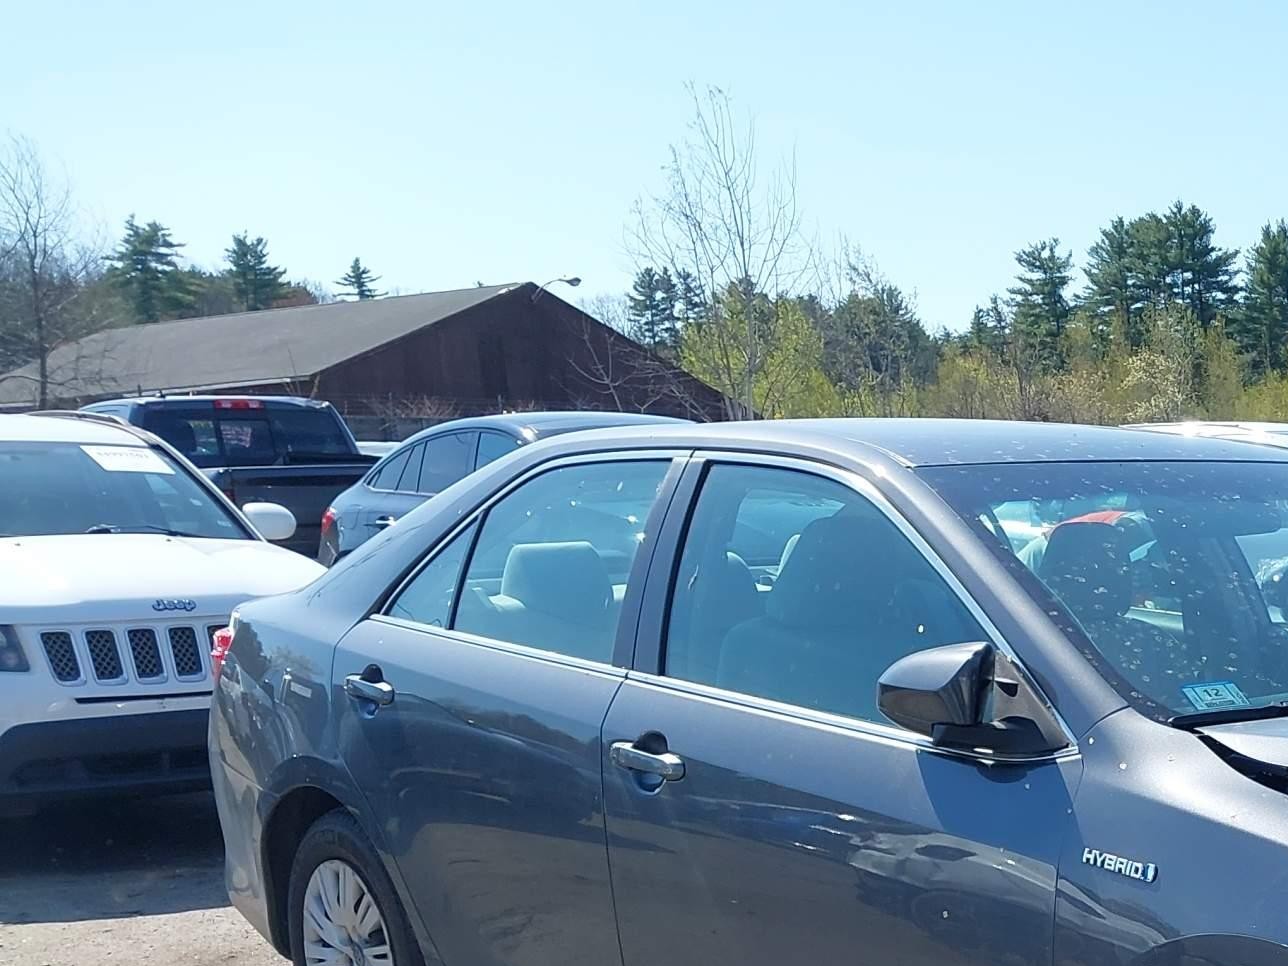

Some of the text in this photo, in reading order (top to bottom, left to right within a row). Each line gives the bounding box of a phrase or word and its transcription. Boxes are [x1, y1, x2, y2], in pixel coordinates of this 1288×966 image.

[152, 599, 197, 611] Jeep
[1203, 688, 1223, 698] 12
[1082, 847, 1144, 880] HYBRID
